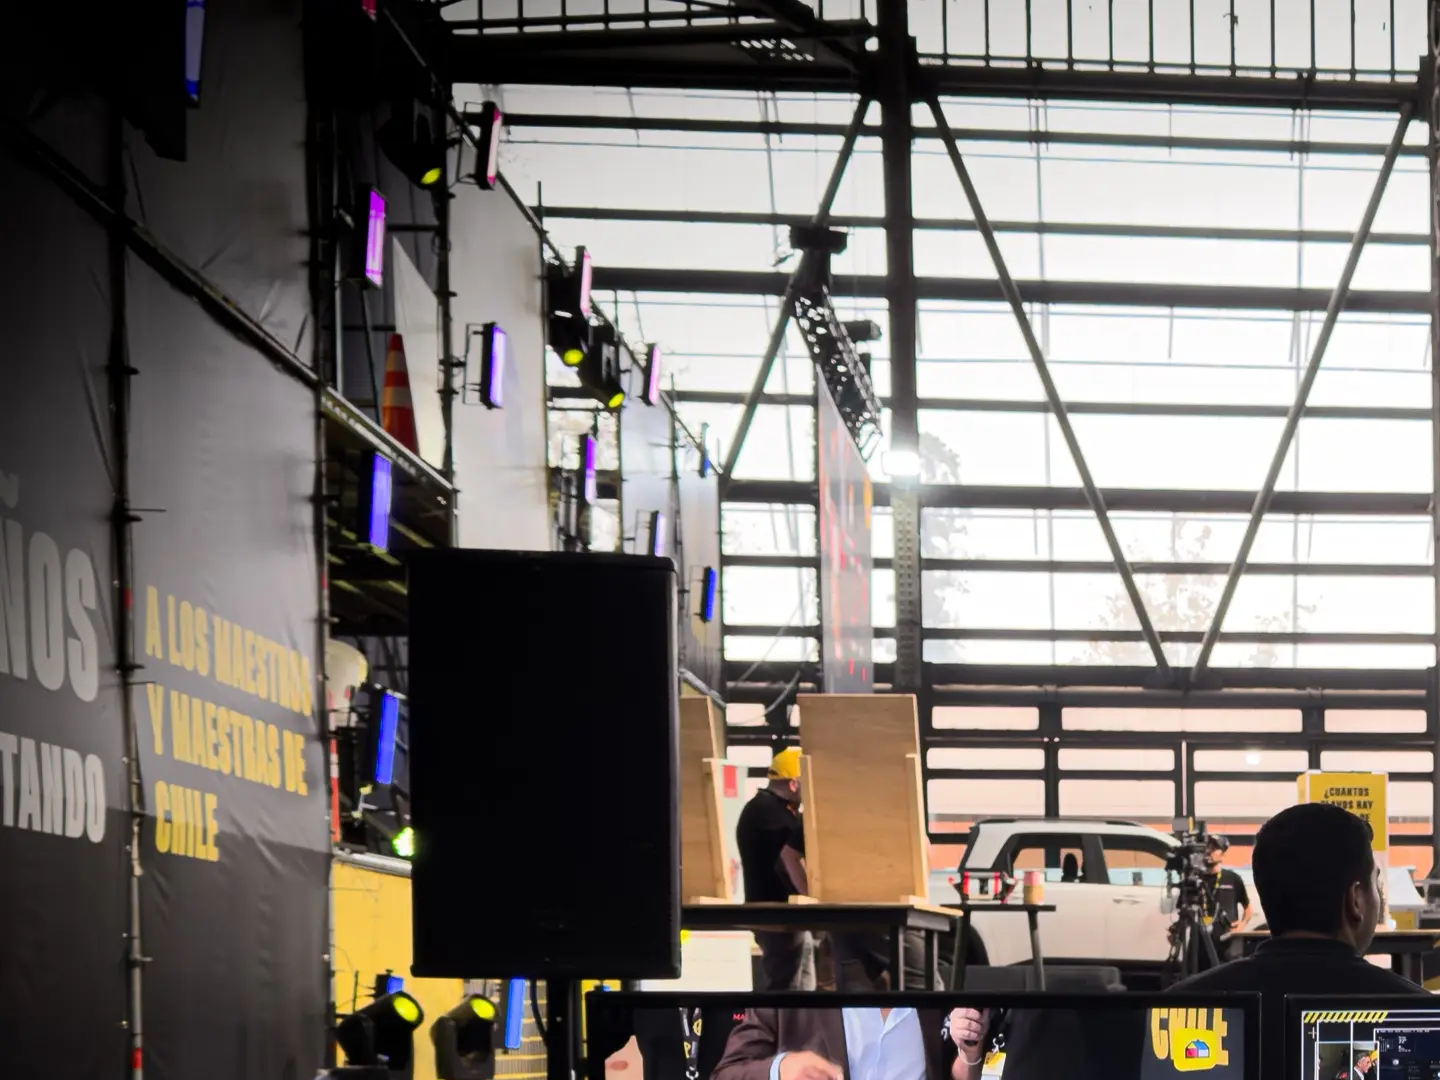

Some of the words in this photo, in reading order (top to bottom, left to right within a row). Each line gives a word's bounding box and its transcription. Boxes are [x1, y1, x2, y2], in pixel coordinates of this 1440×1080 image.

[145, 585, 163, 660] A
[168, 594, 209, 677] LOS
[213, 614, 312, 717] MAESTROS
[146, 682, 164, 756] Y
[170, 689, 281, 789] MAESTRAS
[283, 729, 308, 796] DE
[155, 780, 220, 863] CHILE
